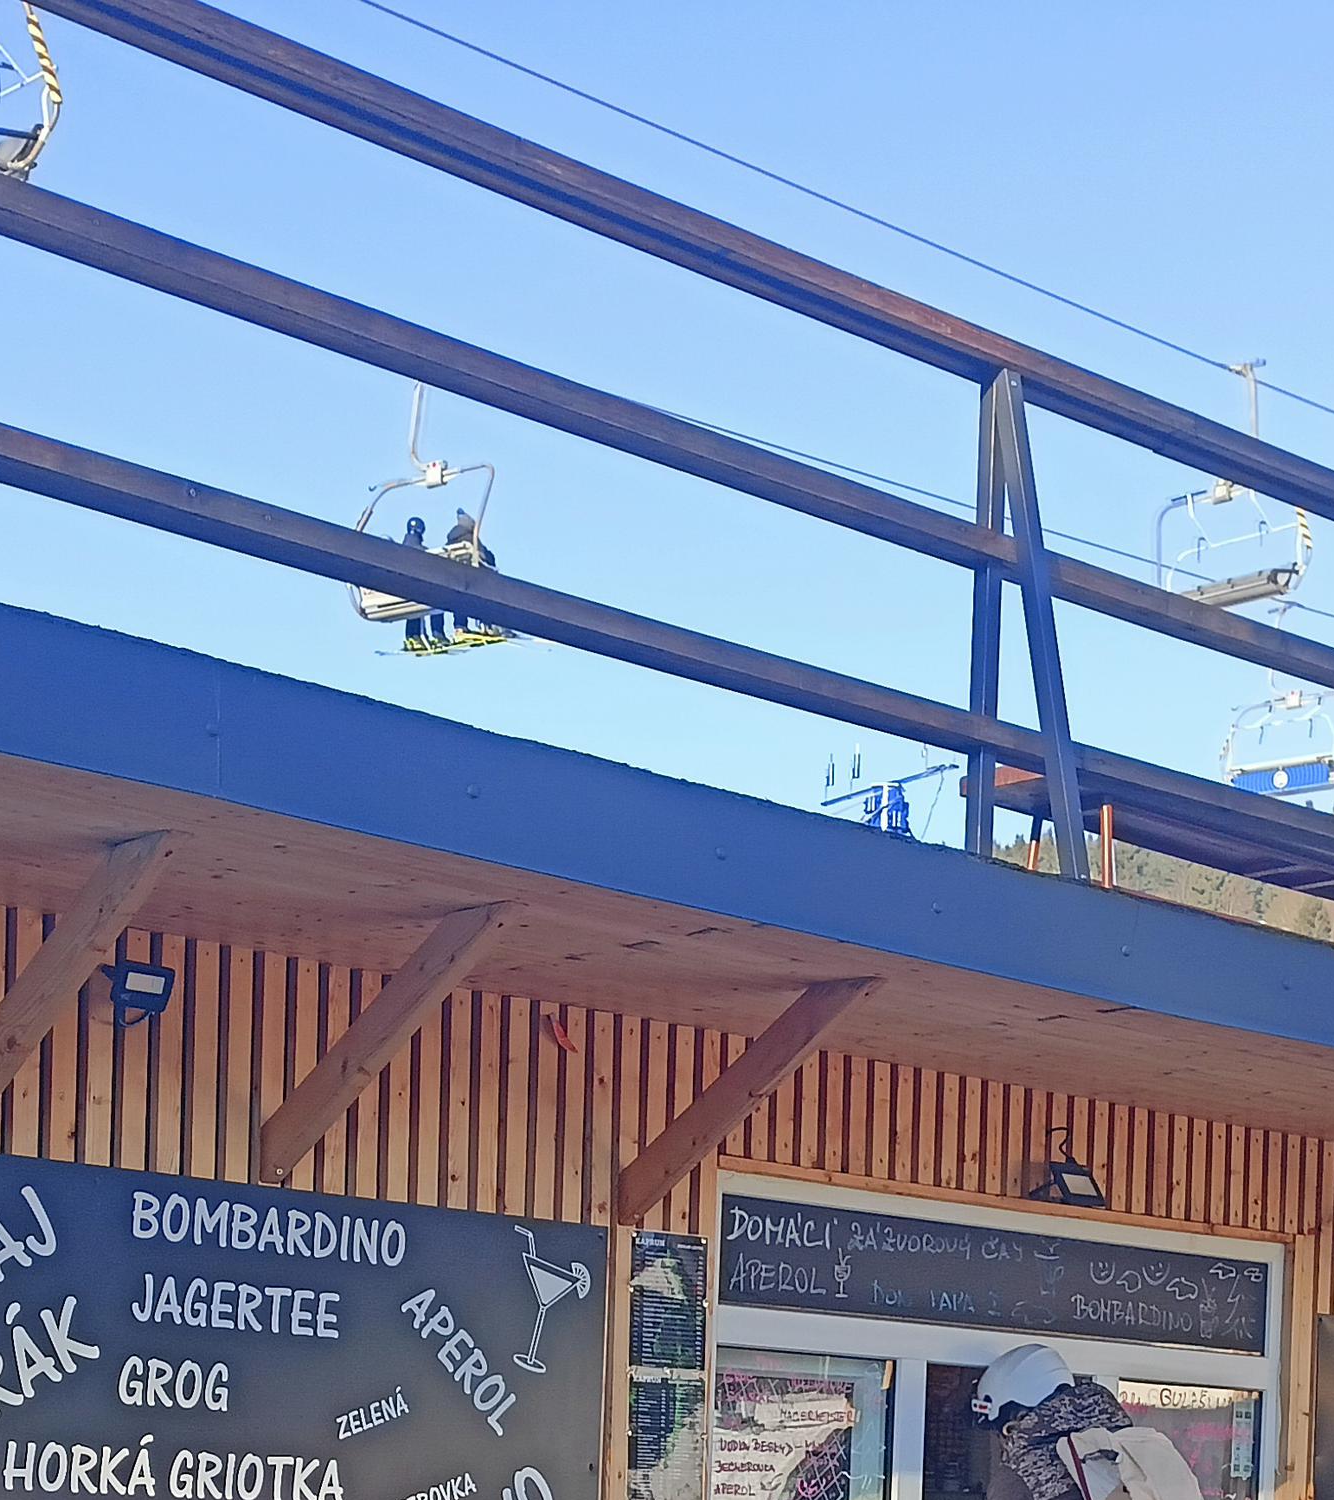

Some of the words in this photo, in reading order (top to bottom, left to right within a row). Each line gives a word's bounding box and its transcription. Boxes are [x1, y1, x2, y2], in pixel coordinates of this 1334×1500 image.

[133, 1191, 406, 1267] BOMBARDINO
[729, 1253, 826, 1295] APEROL
[132, 1274, 340, 1338] JAGERTEE
[1071, 1294, 1193, 1332] BOMBARDINO
[119, 1356, 229, 1412] GROG
[401, 1288, 518, 1436] APEROL
[336, 1387, 409, 1439] ZELENÁ
[3, 1435, 156, 1497] HORKÁ
